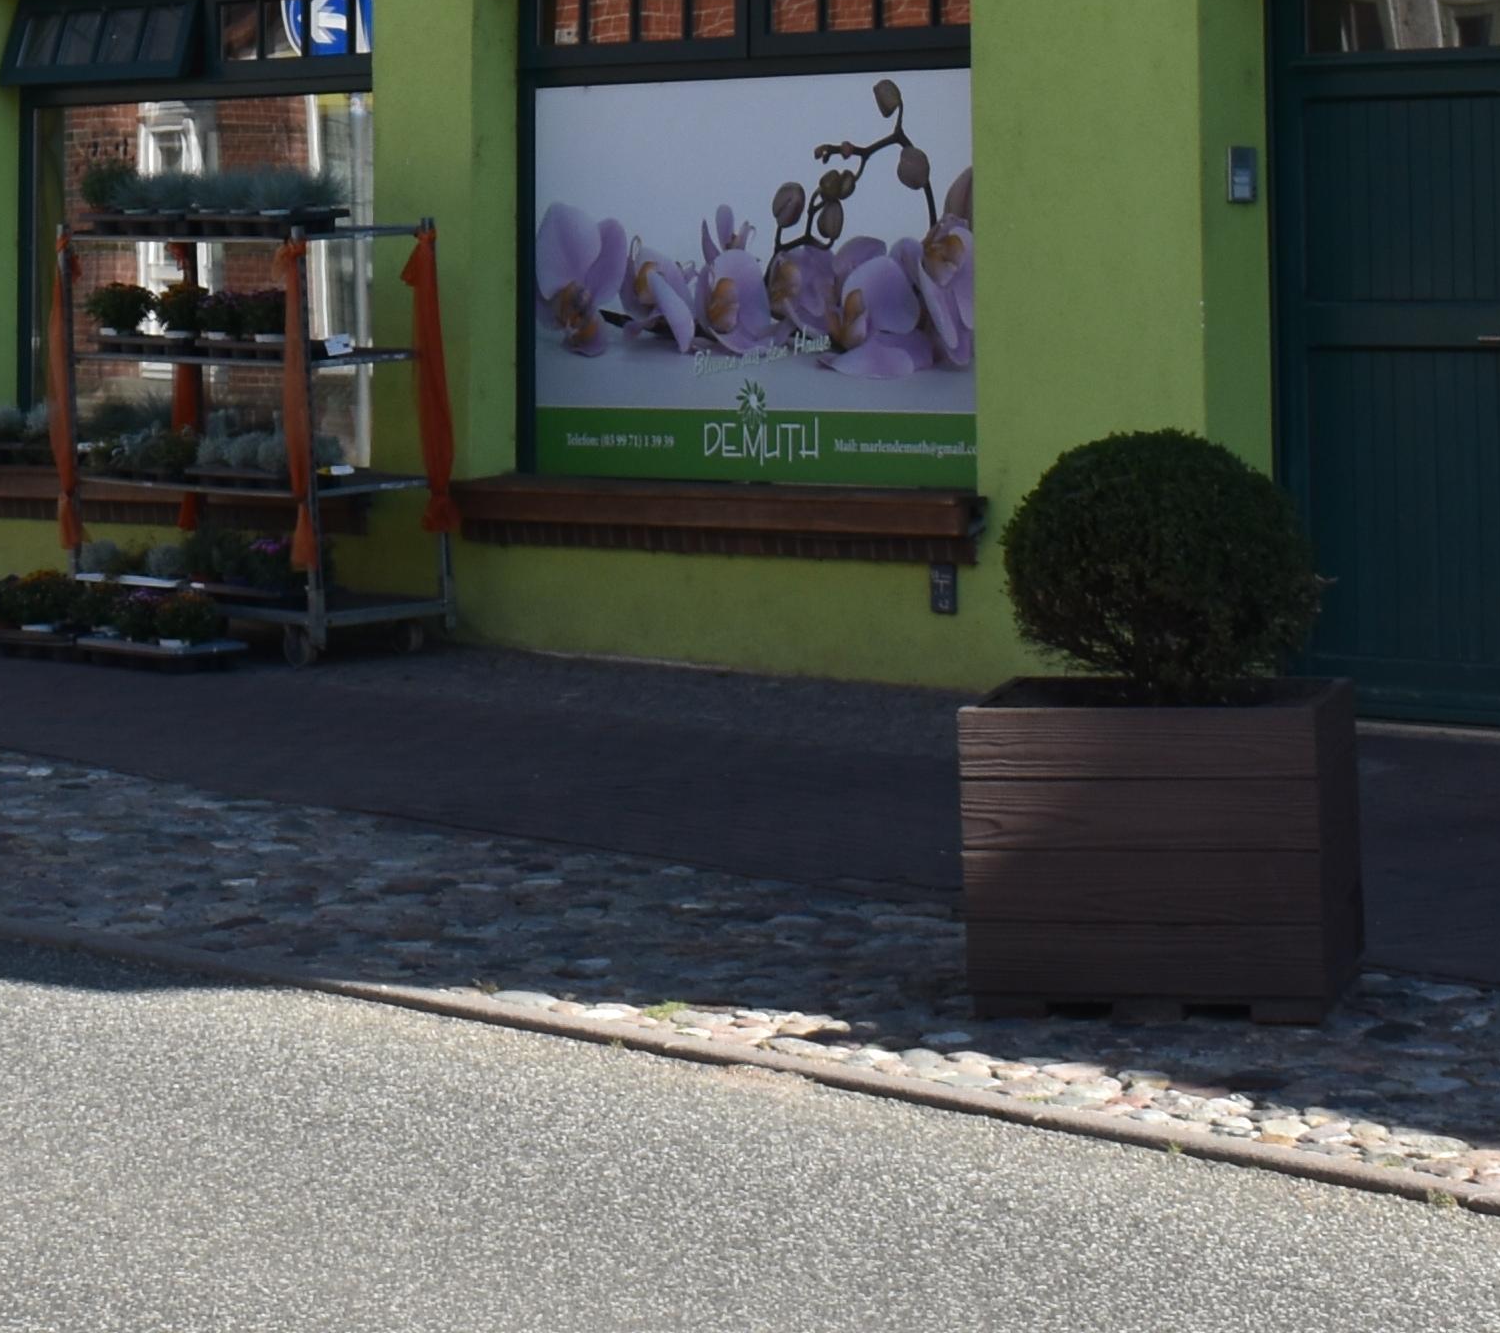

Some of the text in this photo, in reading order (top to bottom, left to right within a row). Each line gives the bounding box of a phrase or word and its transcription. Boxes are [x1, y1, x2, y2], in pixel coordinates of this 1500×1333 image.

[793, 324, 832, 356] Hause
[566, 433, 599, 446] Telefon:
[704, 416, 819, 466] DEMUTH
[834, 438, 858, 452] Mail:
